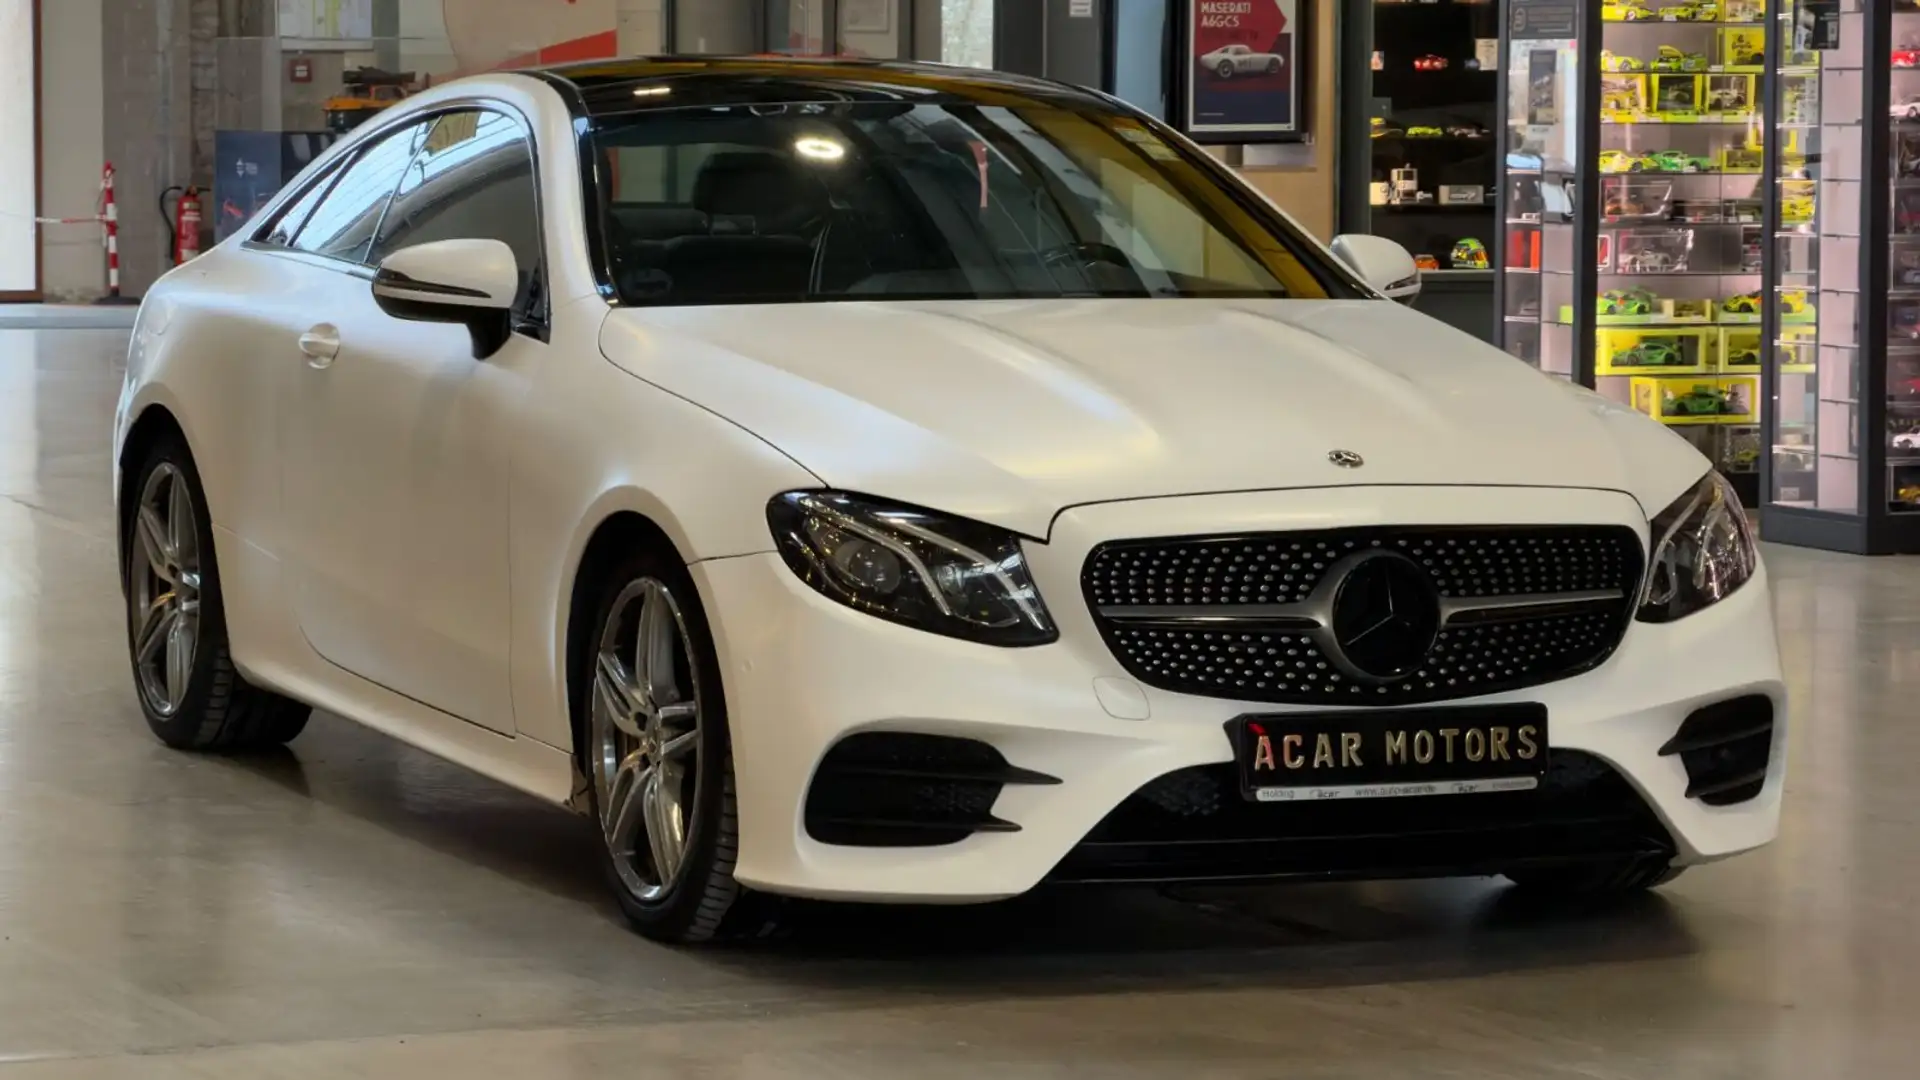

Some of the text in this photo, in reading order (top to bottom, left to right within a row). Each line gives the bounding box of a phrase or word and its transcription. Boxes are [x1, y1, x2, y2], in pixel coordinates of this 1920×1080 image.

[1200, 1, 1251, 13] MASERATI
[1255, 725, 1538, 770] ACAR MOTORS
